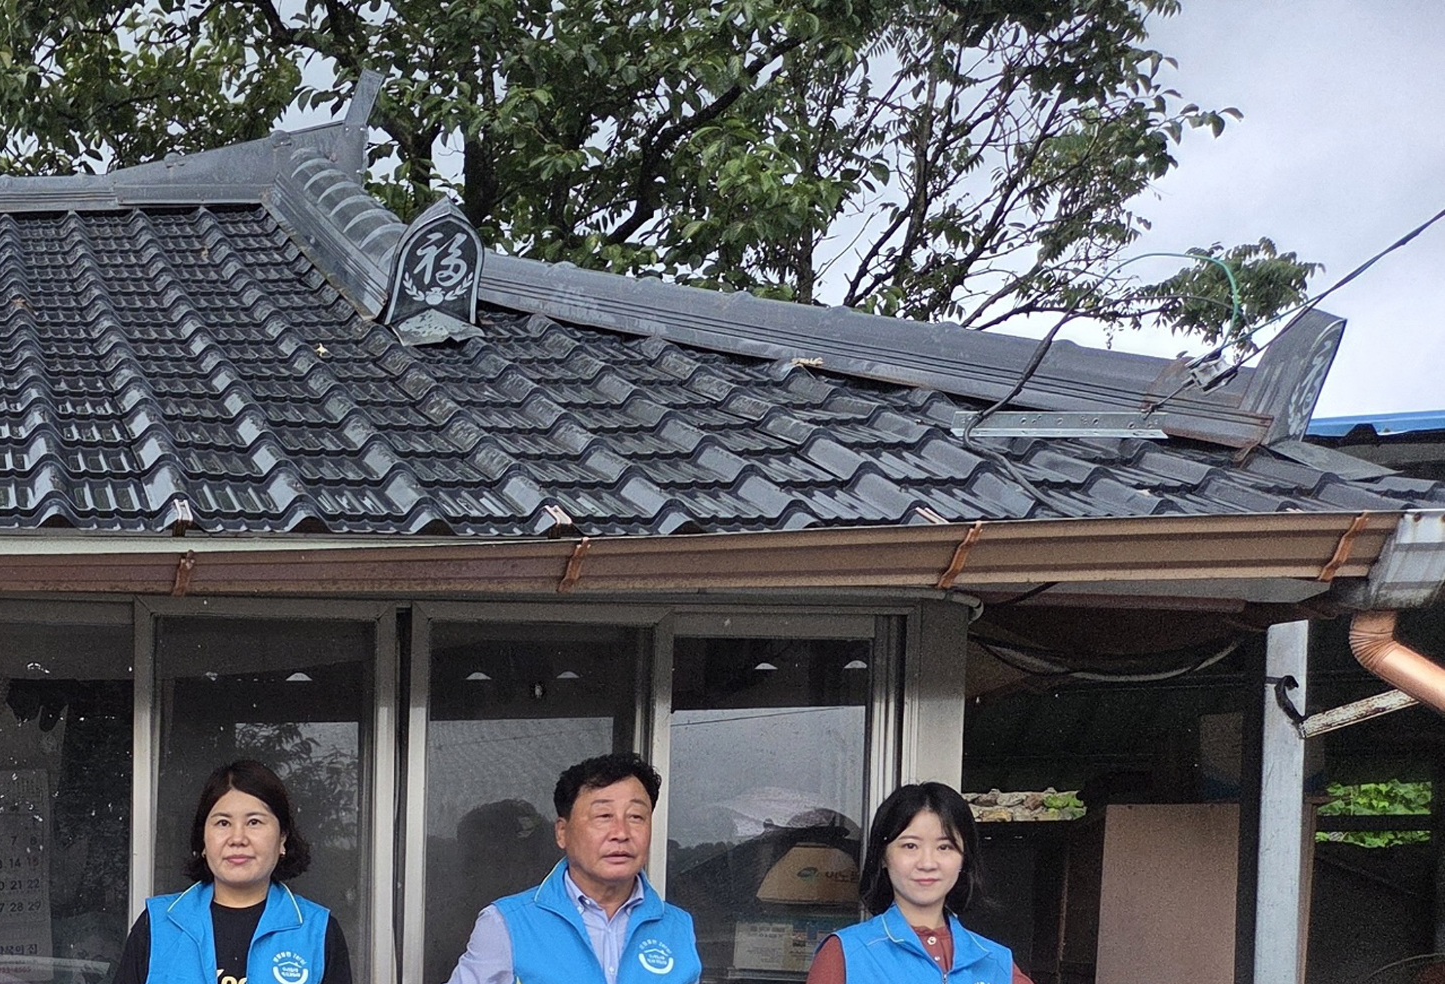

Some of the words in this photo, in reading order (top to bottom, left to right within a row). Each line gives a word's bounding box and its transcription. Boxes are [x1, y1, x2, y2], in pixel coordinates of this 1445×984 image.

[11, 835, 18, 846] 7
[9, 858, 21, 868] 14
[10, 880, 22, 890] 21
[27, 878, 39, 889] 22
[10, 902, 23, 912] 28
[28, 901, 41, 911] 29
